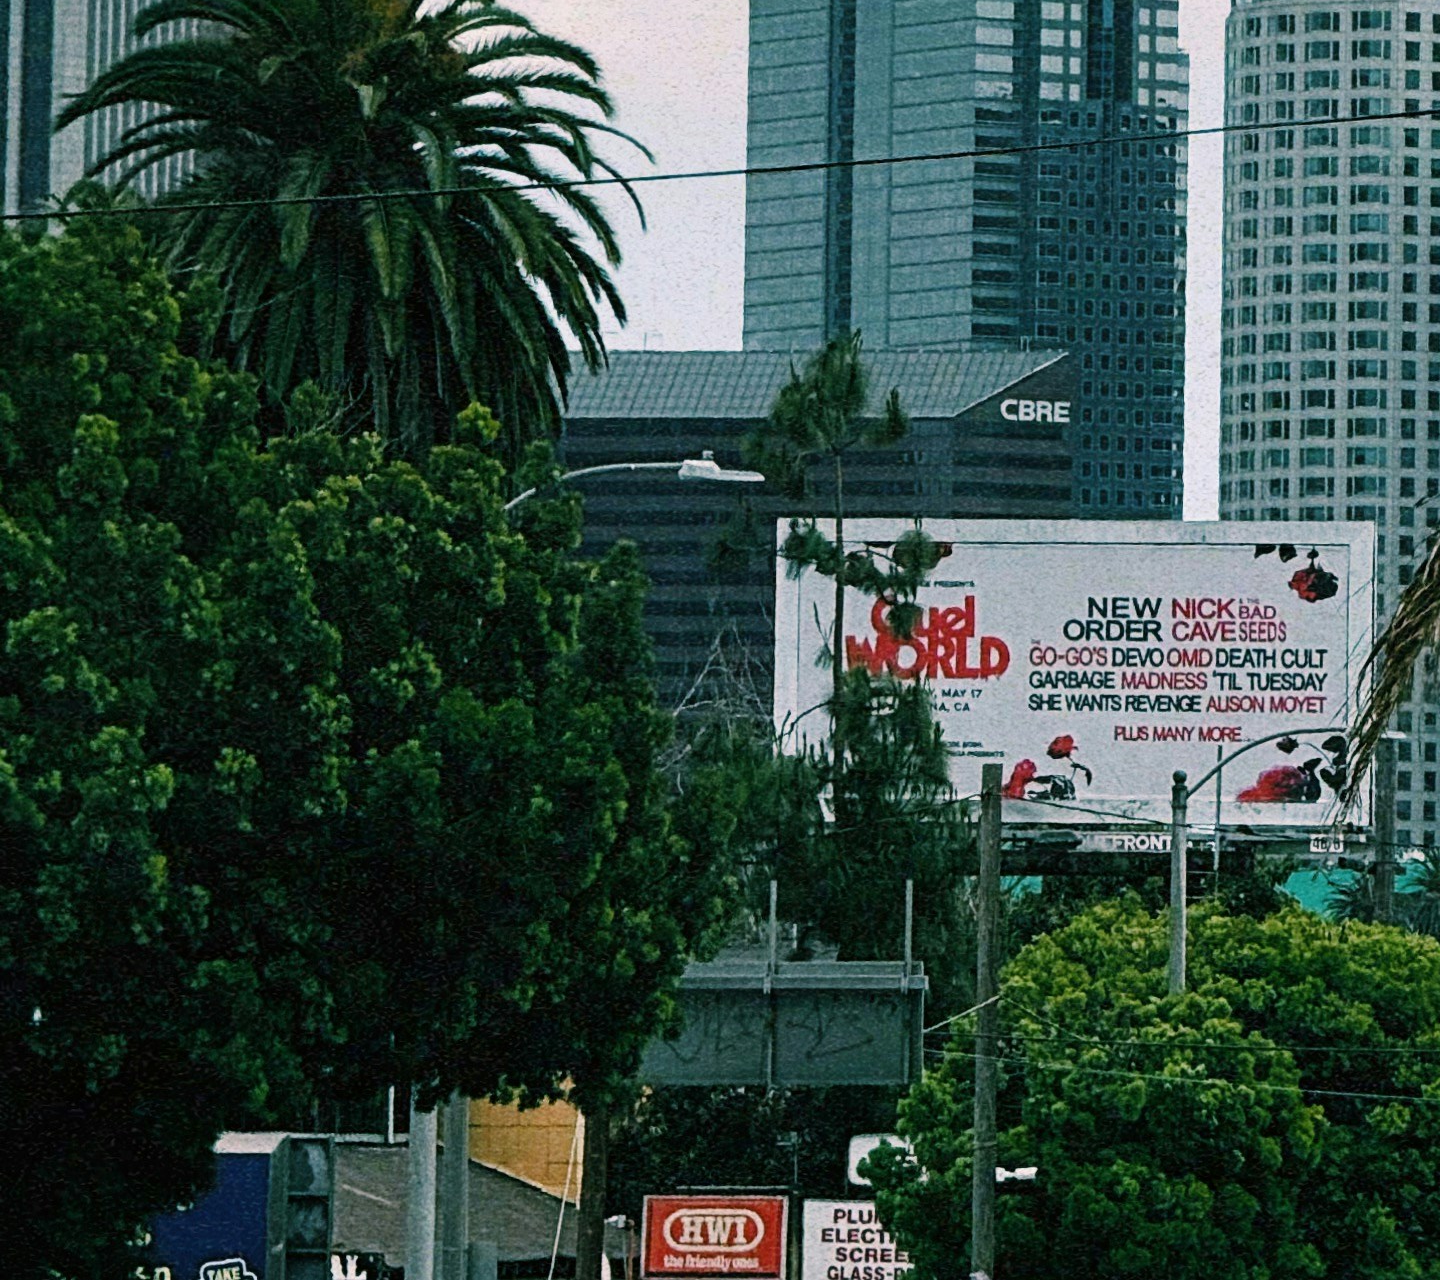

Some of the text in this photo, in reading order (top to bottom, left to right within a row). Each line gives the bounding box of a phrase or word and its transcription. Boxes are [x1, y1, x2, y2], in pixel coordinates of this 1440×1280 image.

[1000, 399, 1071, 423] CBRE
[871, 595, 975, 638] Cuel
[1088, 597, 1236, 619] NEW NICK
[1238, 606, 1276, 619] BAD
[1063, 619, 1287, 642] ORDER CAVE SEEDS
[845, 635, 1010, 679] WORLD
[1029, 646, 1328, 668] GO-GO'S DEVO OMD DEATH CULT
[1029, 670, 1115, 689] GARBAGE
[1121, 671, 1208, 690] MADNESS
[1249, 672, 1328, 692] TUESDAY
[941, 689, 966, 698] MAY
[971, 689, 983, 698] 17
[953, 702, 970, 712] CA
[1028, 694, 1327, 714] SHE WANTS REVENGE ALISON MOYET
[1114, 726, 1149, 741] PLUS
[1153, 726, 1195, 742] MANY
[833, 1208, 881, 1224] PLU
[679, 1216, 748, 1243] HWI
[664, 1254, 684, 1268] the
[685, 1254, 732, 1272] friendly
[835, 1247, 910, 1263] SCREE
[207, 1267, 242, 1280] TAKE
